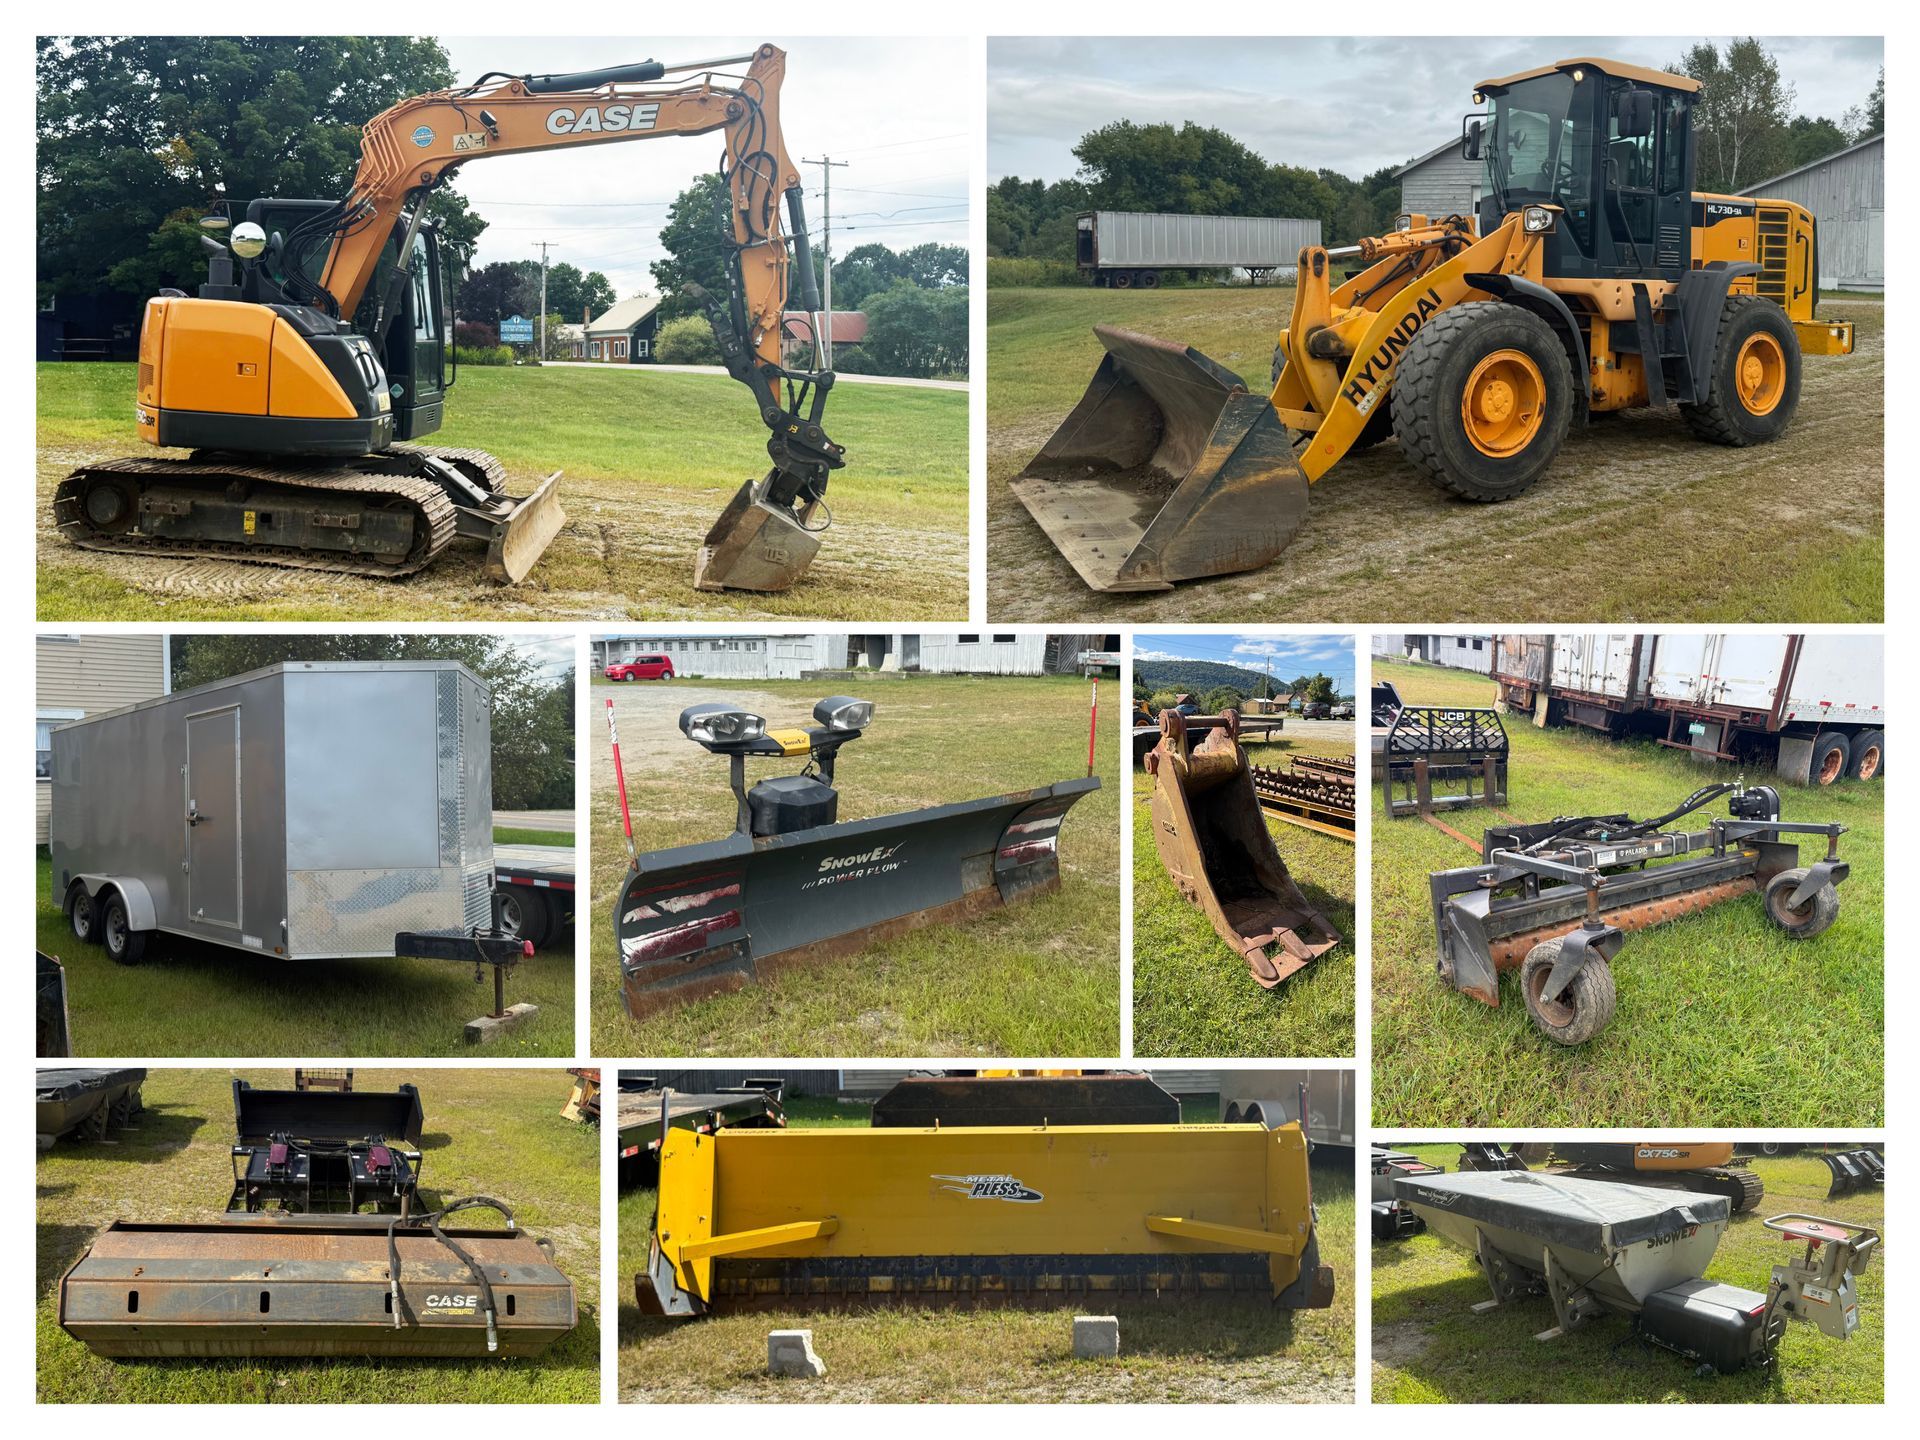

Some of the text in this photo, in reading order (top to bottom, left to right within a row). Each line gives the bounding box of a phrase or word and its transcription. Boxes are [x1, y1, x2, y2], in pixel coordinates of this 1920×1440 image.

[545, 103, 660, 135] CASE
[1707, 205, 1742, 215] HL730-9A
[1342, 287, 1442, 407] HYUNDAI
[1440, 712, 1465, 720] JCB
[817, 861, 900, 887] POWER FLOW
[1638, 1149, 1678, 1158] CX75C
[966, 1175, 1012, 1183] METAL
[972, 1182, 1020, 1196] PLESS
[426, 1295, 477, 1307] CASE
